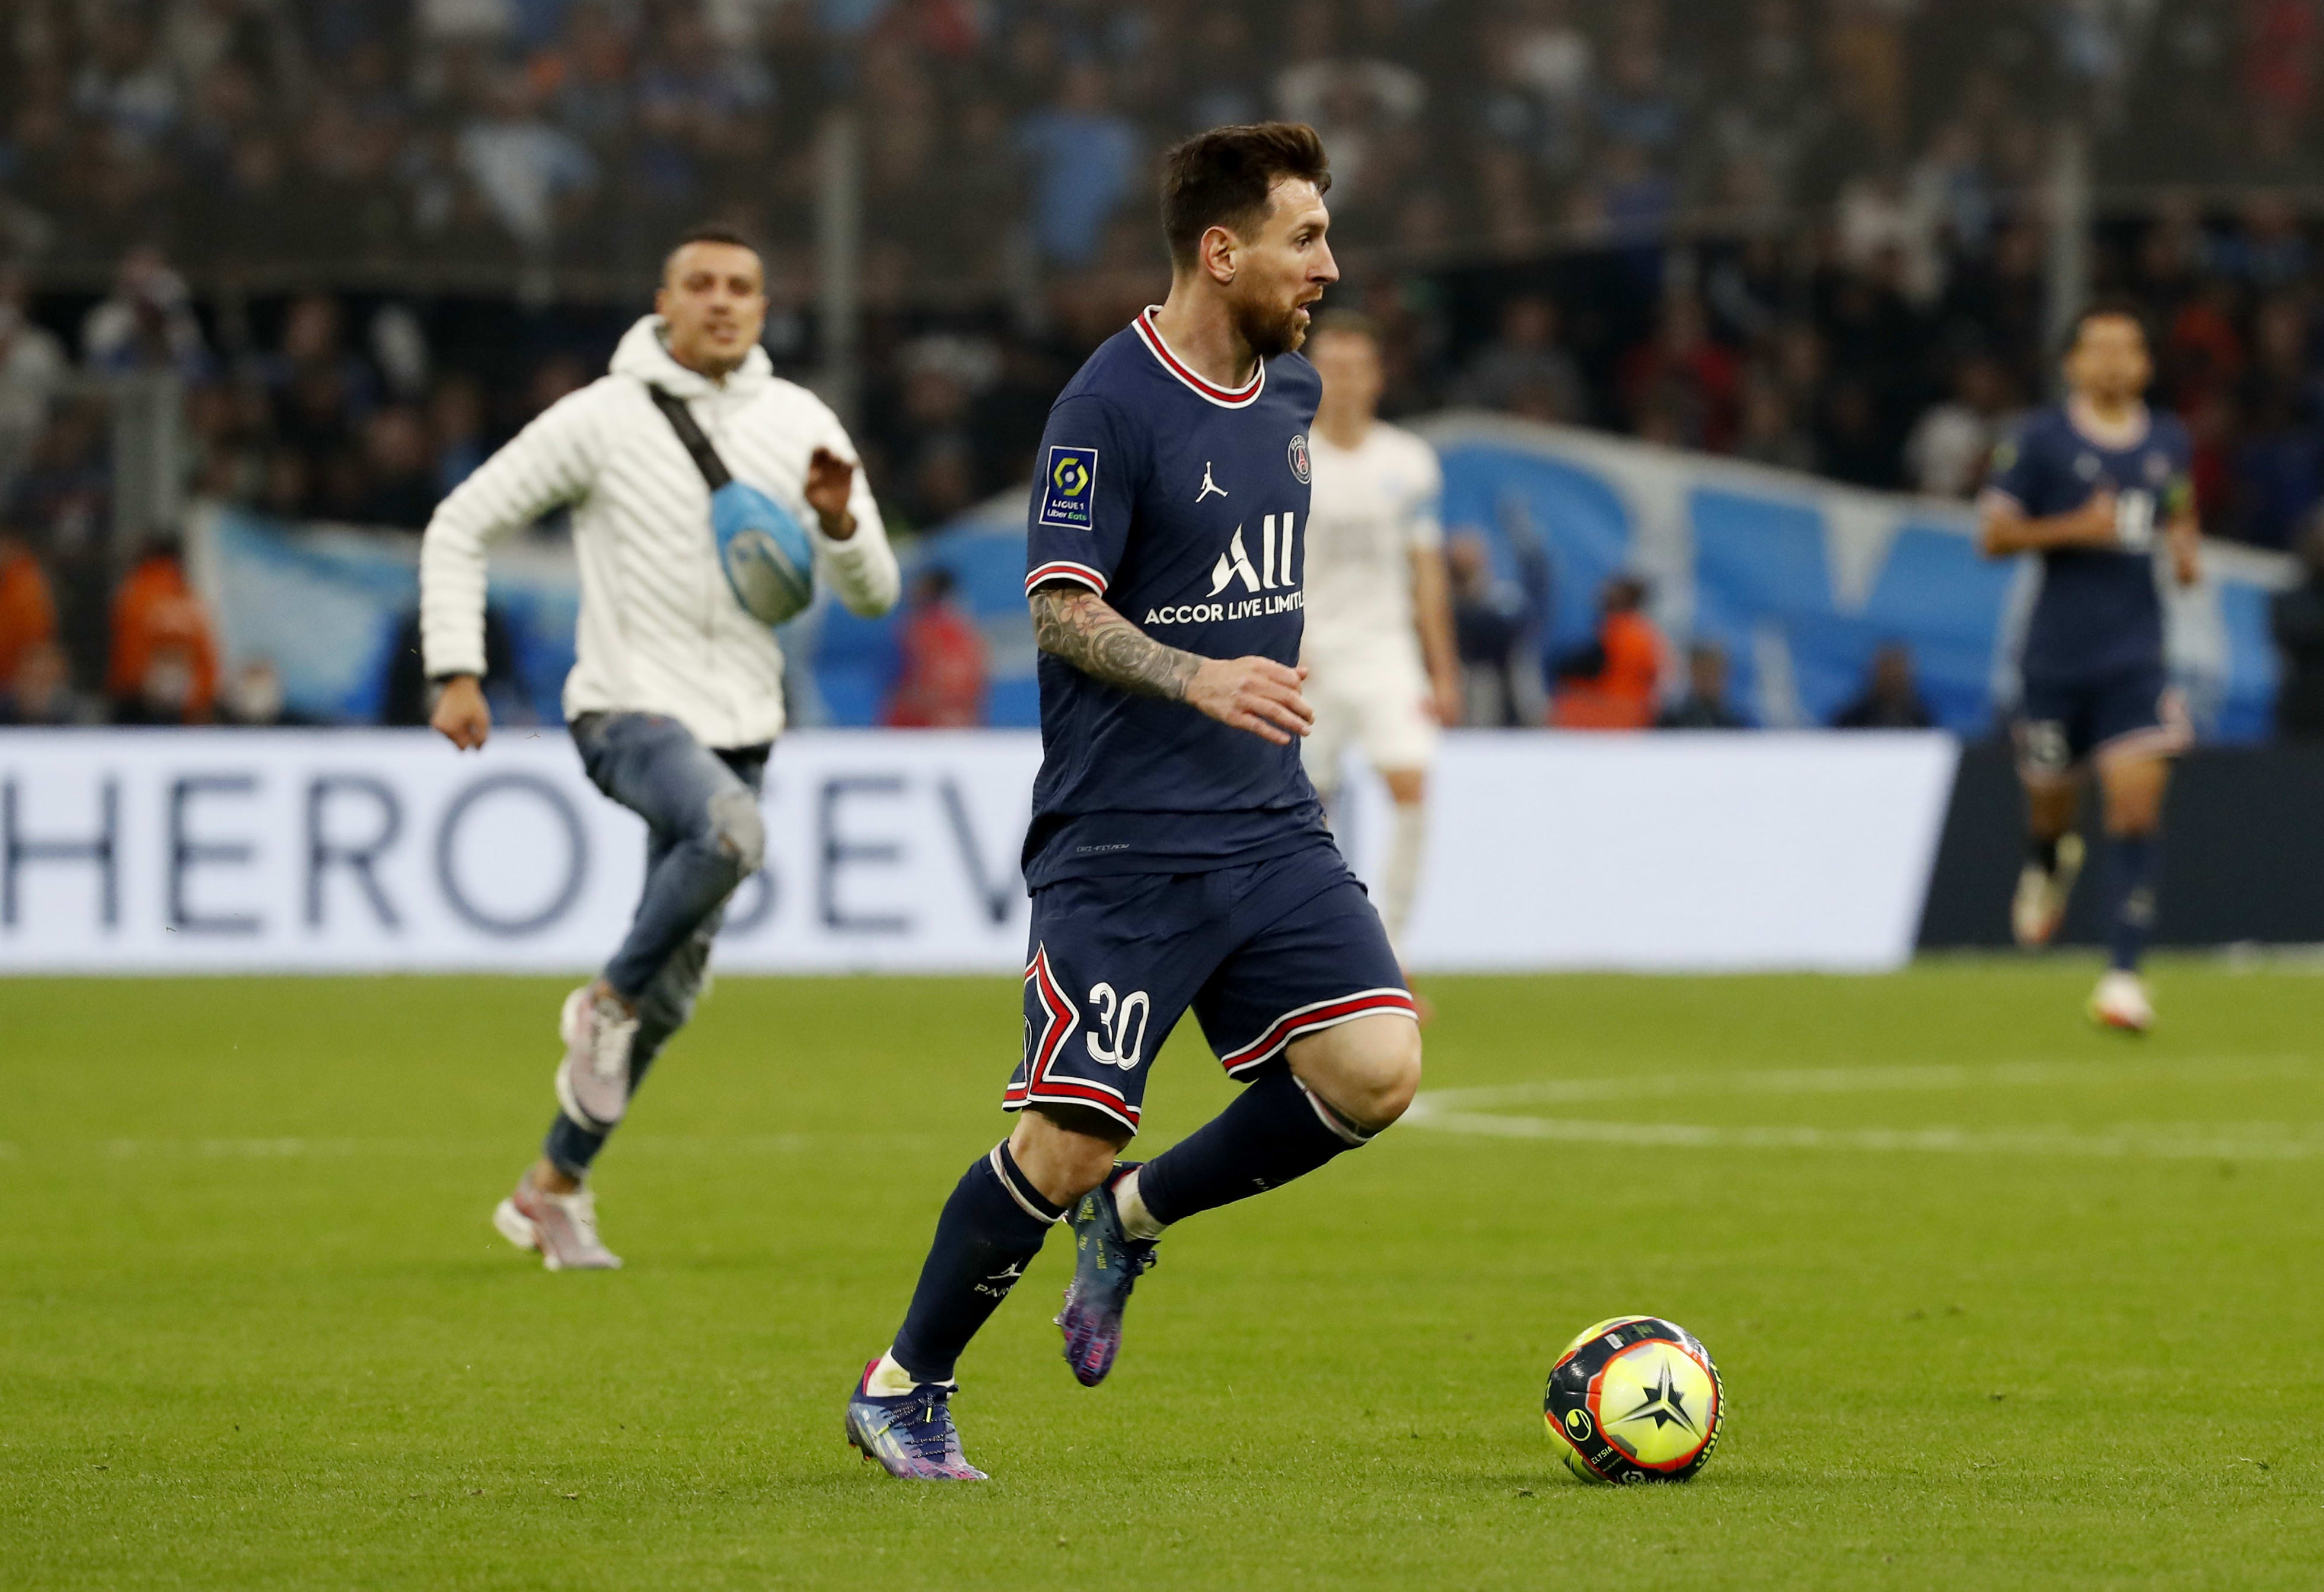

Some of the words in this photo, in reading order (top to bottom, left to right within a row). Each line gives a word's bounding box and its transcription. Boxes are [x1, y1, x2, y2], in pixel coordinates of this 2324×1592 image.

[1047, 508, 1067, 518] Uber
[1068, 512, 1087, 521] Eats
[1052, 499, 1078, 510] LIGUE
[1144, 603, 1224, 625] ACCOR
[1228, 597, 1263, 620] LIVE
[2, 773, 590, 938] HERO
[1086, 982, 1150, 1070] 30
[1590, 1445, 1614, 1465] ELYSIA
